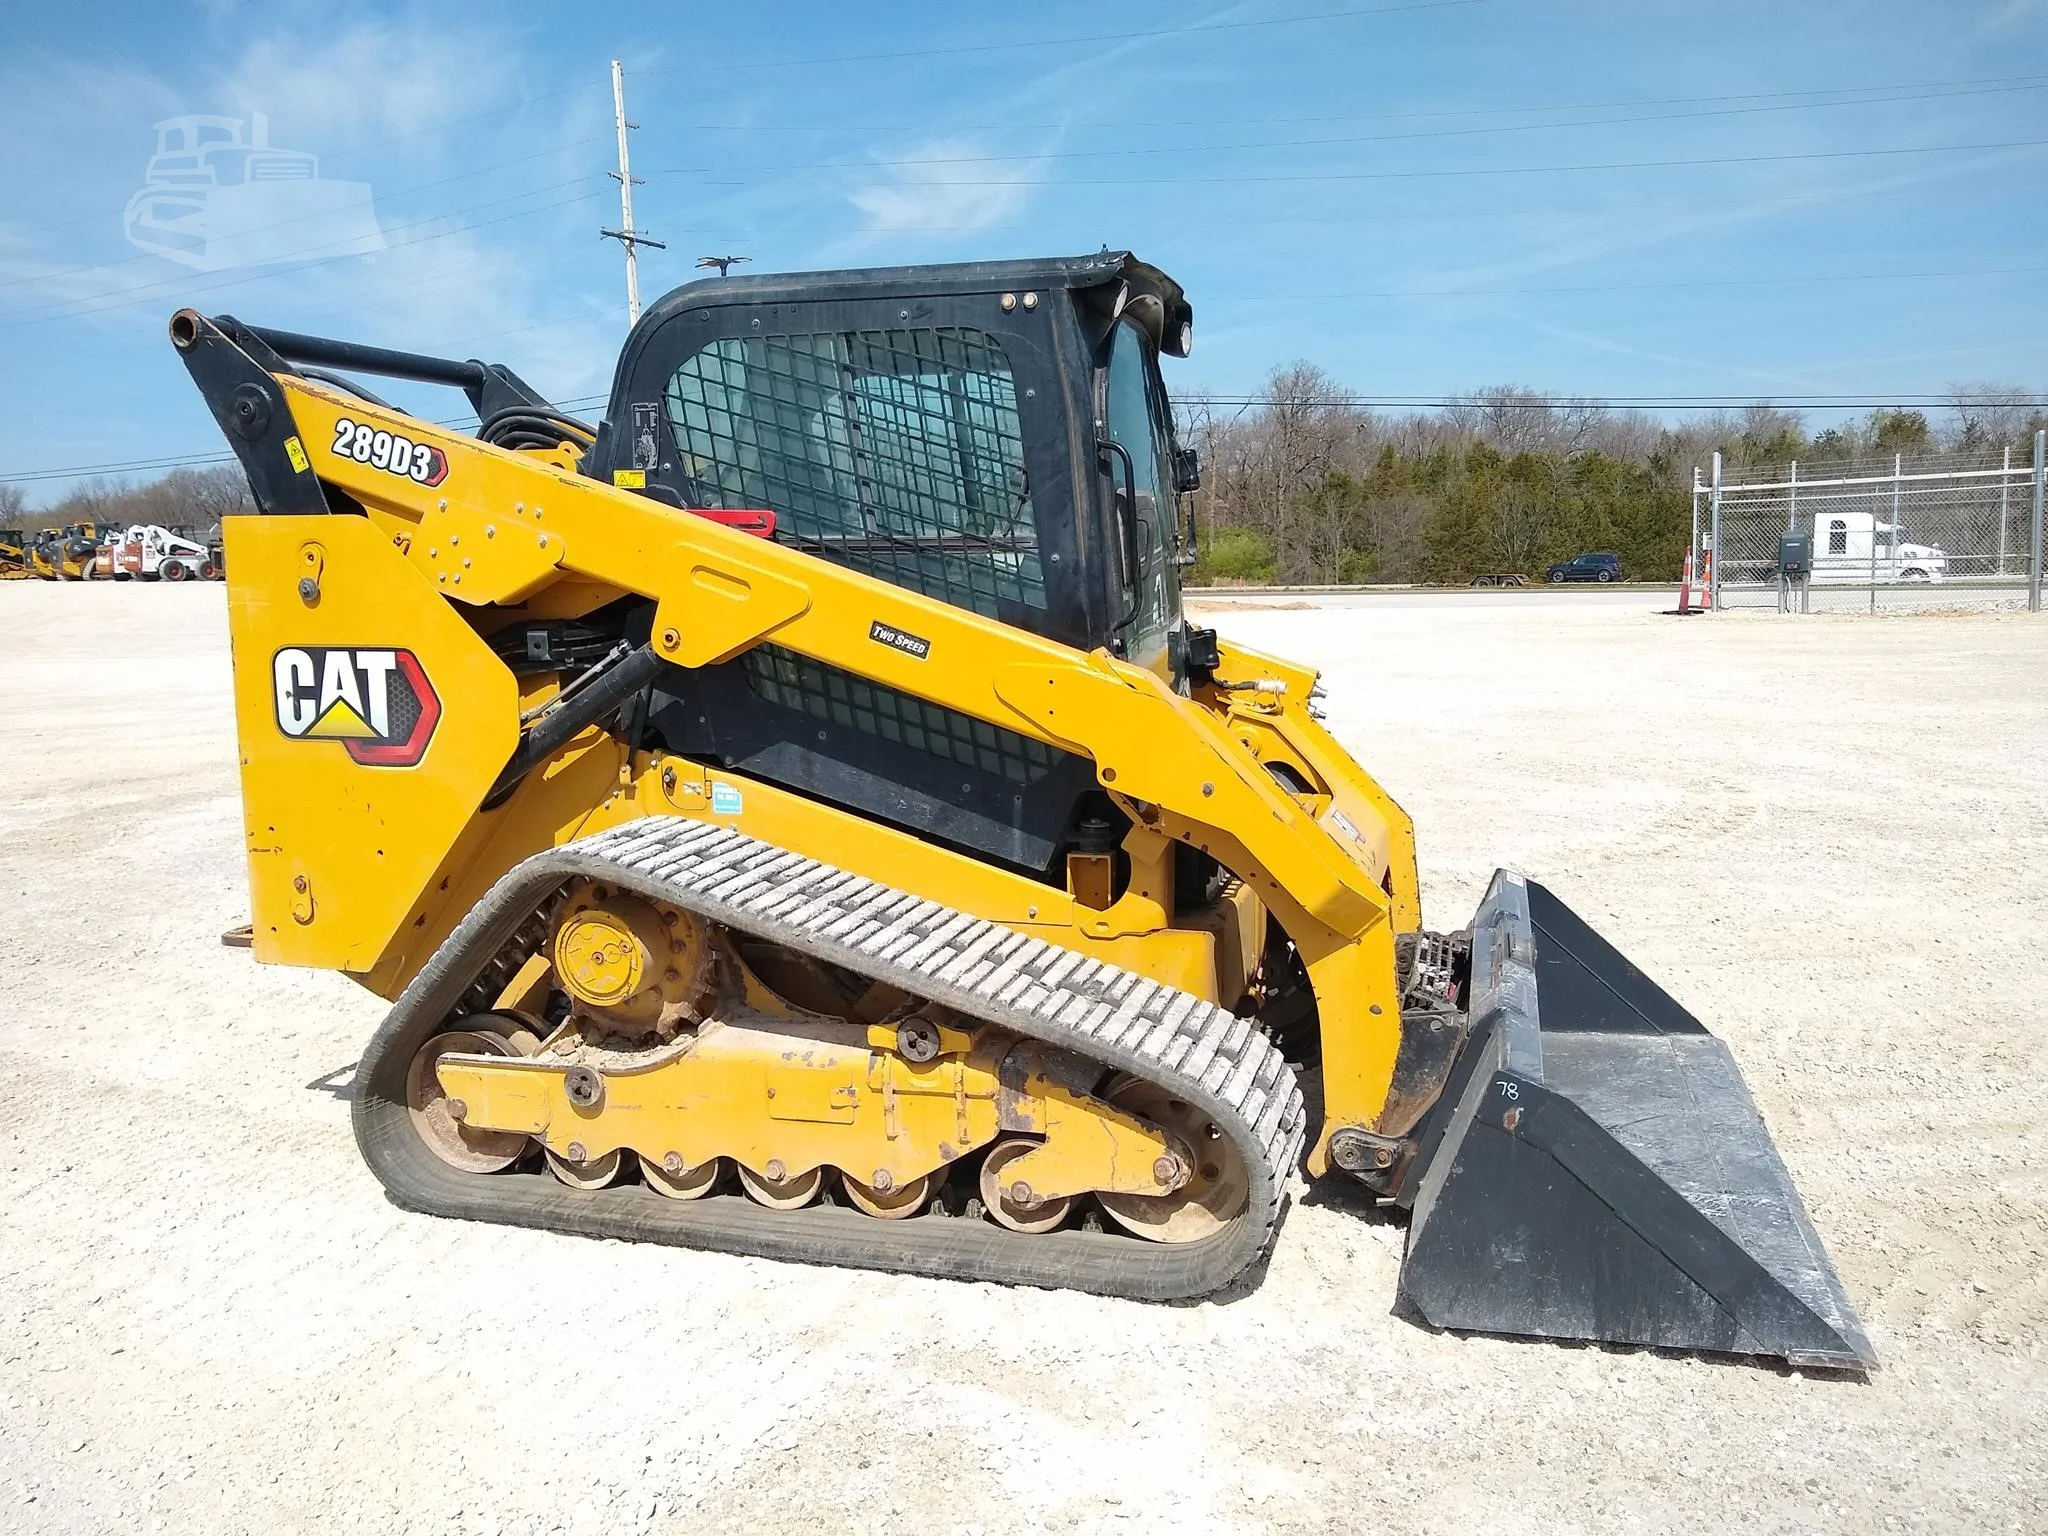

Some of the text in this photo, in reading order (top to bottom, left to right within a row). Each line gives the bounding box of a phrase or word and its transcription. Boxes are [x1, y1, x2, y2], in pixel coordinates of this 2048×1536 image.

[332, 419, 432, 482] 289D3
[274, 648, 397, 738] CAT
[1496, 1081, 1519, 1100] 78
